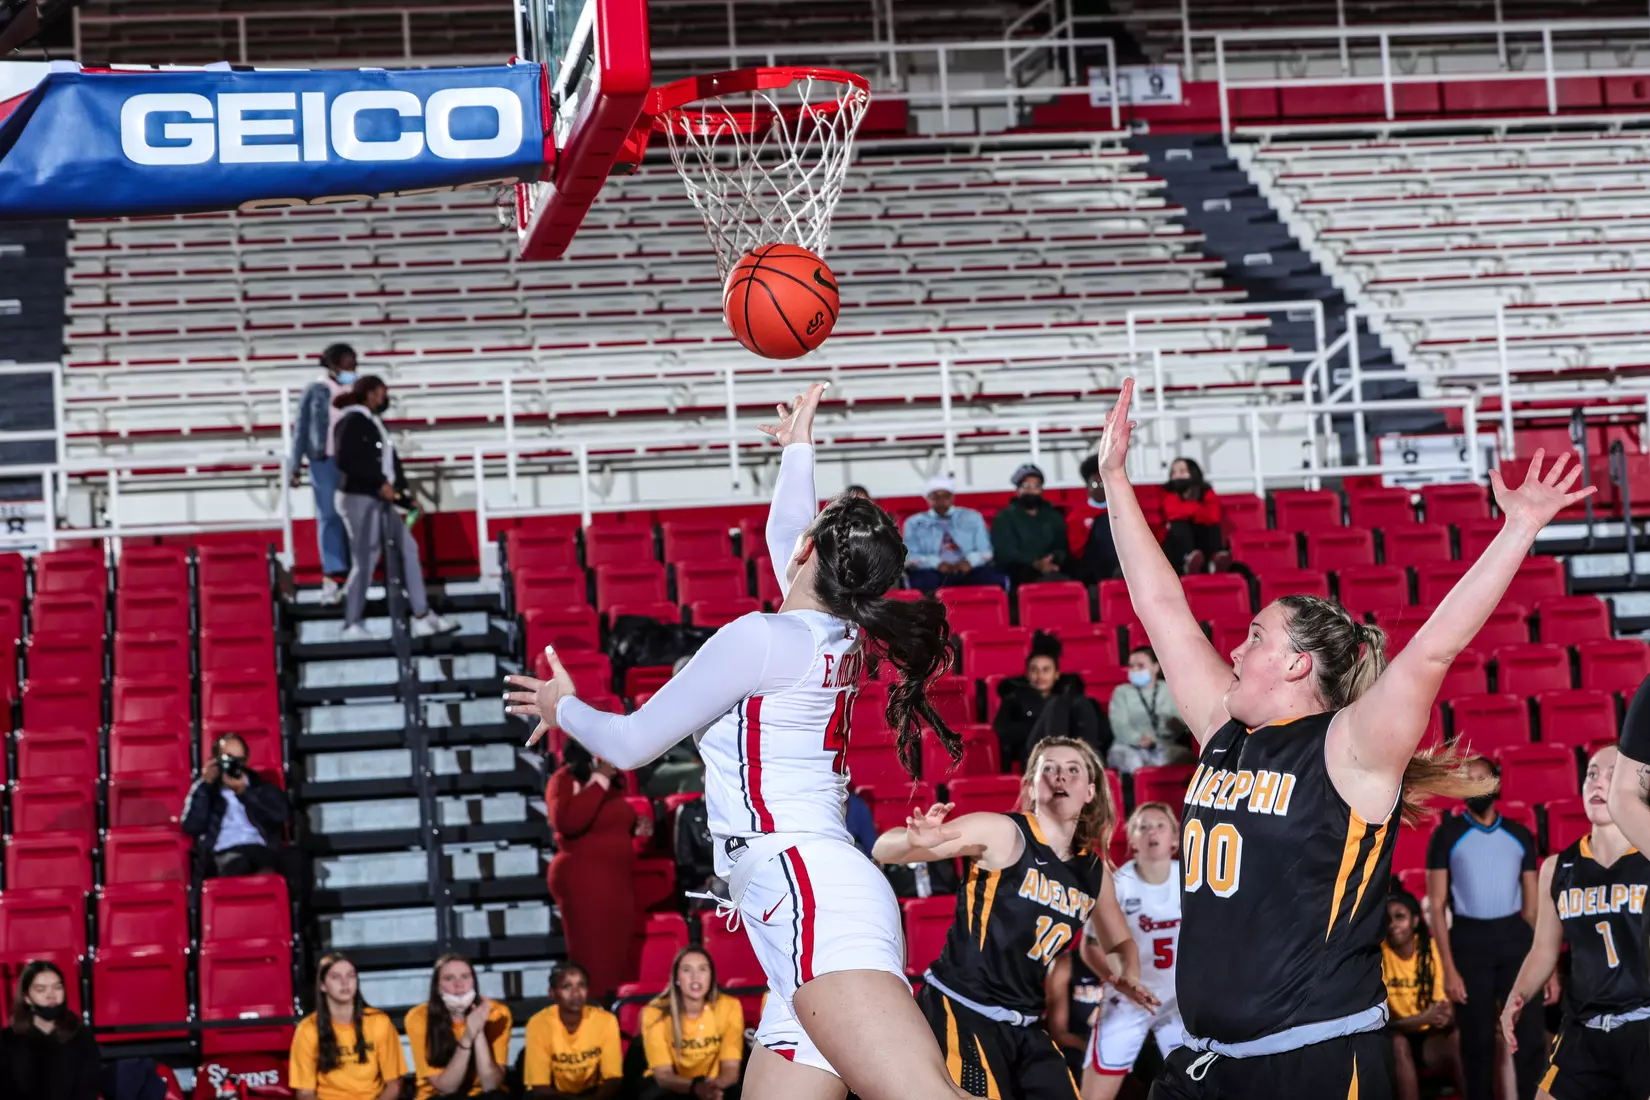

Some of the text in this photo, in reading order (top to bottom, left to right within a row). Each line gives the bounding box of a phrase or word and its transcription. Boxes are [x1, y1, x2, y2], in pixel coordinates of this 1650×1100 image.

[120, 87, 522, 165] GEICO
[822, 653, 834, 688] E.
[1184, 763, 1296, 816] ADELPHI
[730, 838, 739, 848] M
[1183, 818, 1243, 898] 00
[1557, 883, 1648, 920] ADELPH
[1027, 915, 1072, 967] 10
[1153, 937, 1173, 969] 5
[1595, 920, 1620, 968] 1
